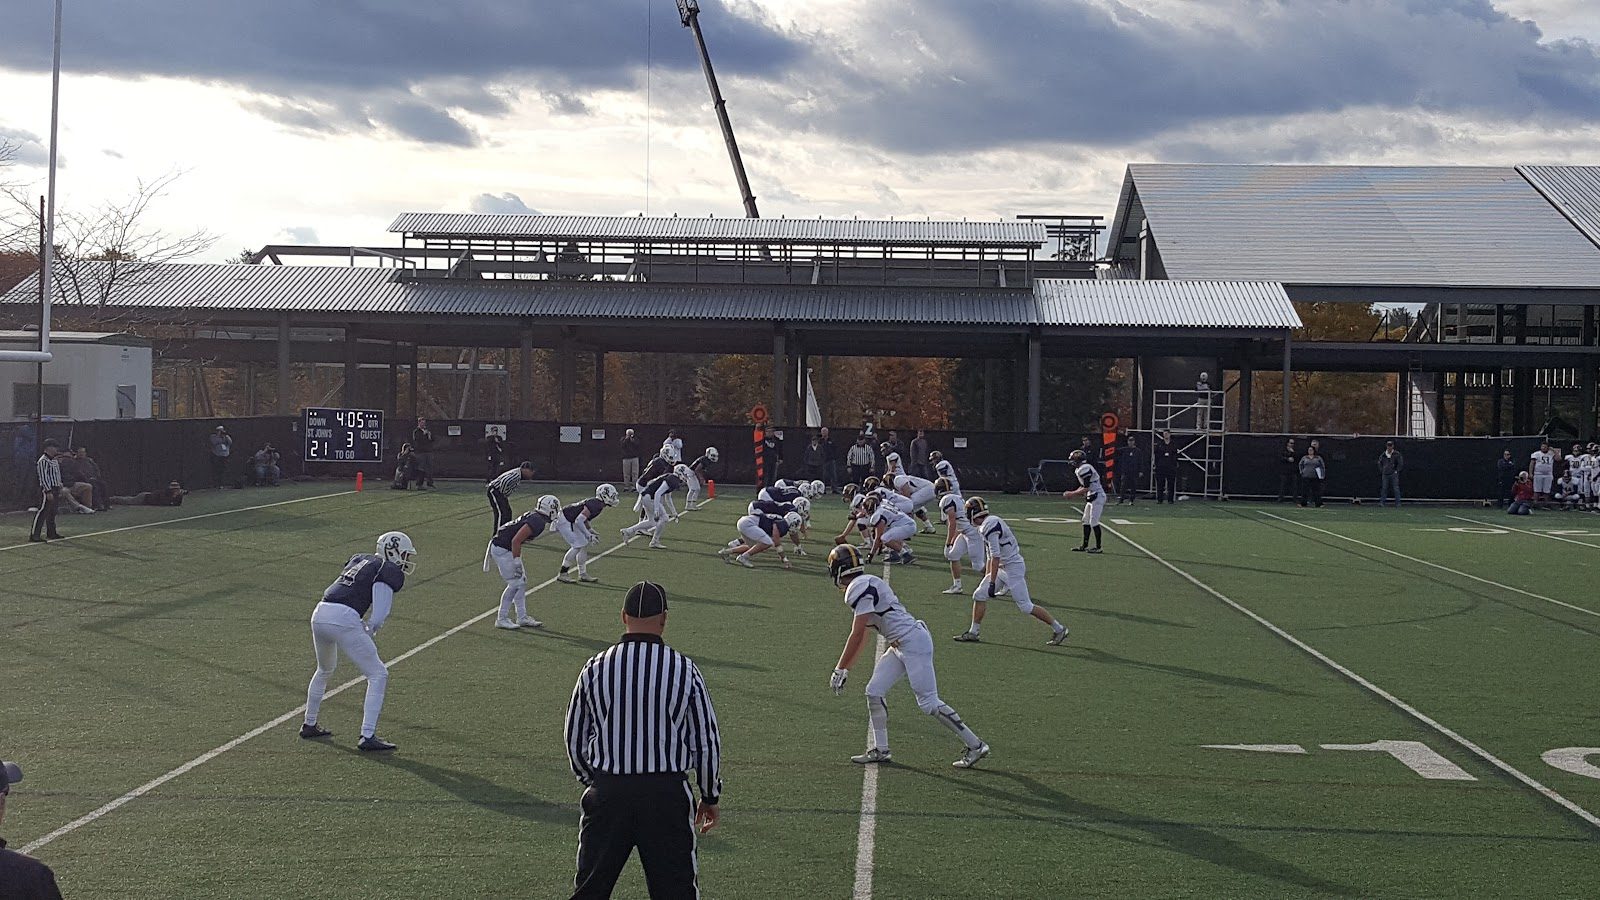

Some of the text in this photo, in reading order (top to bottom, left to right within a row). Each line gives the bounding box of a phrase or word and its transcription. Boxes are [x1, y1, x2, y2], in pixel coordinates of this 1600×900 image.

[309, 418, 326, 426] DOWN
[337, 412, 364, 428] 4:05
[368, 420, 379, 428] QTR
[347, 432, 354, 447] 3
[360, 430, 381, 439] GUEST
[311, 441, 327, 457] 21
[335, 450, 355, 459] TO GO
[372, 442, 378, 457] 7
